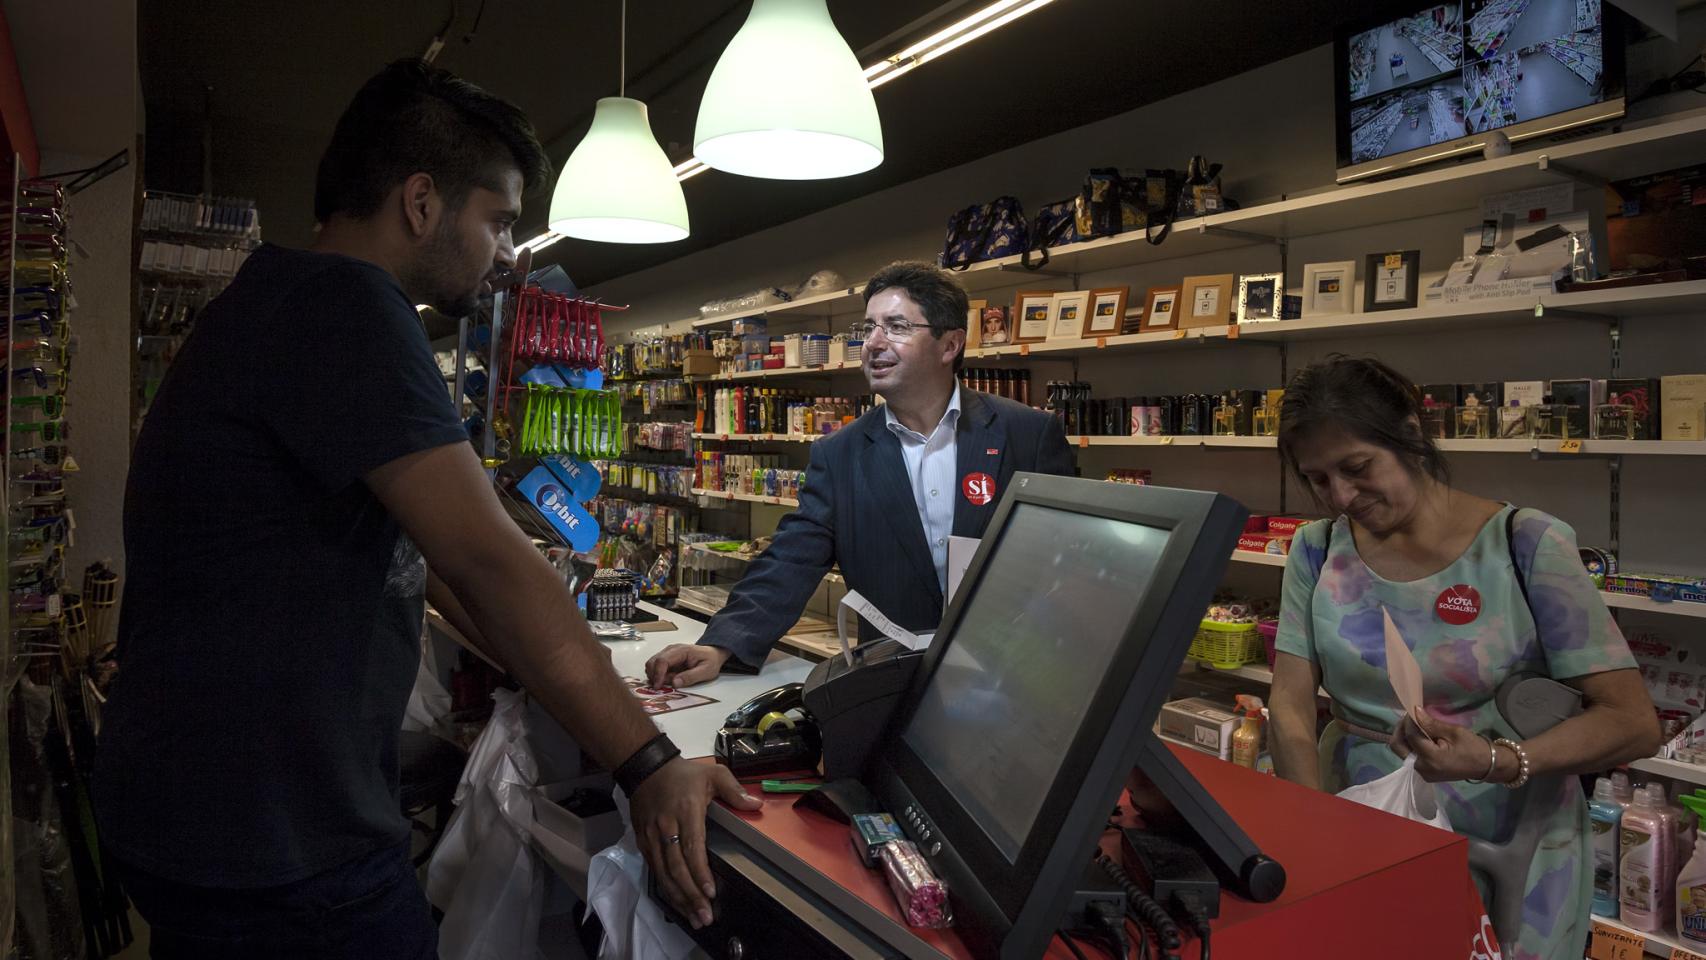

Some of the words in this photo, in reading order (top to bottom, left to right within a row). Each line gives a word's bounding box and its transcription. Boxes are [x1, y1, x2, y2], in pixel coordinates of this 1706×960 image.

[536, 483, 580, 530] Orbit
[1268, 520, 1296, 530] Colgate
[1238, 538, 1265, 548] Colgate
[1609, 584, 1649, 595] mentos
[1447, 596, 1473, 607] VOTA
[1438, 602, 1478, 613] SOCIALISTA
